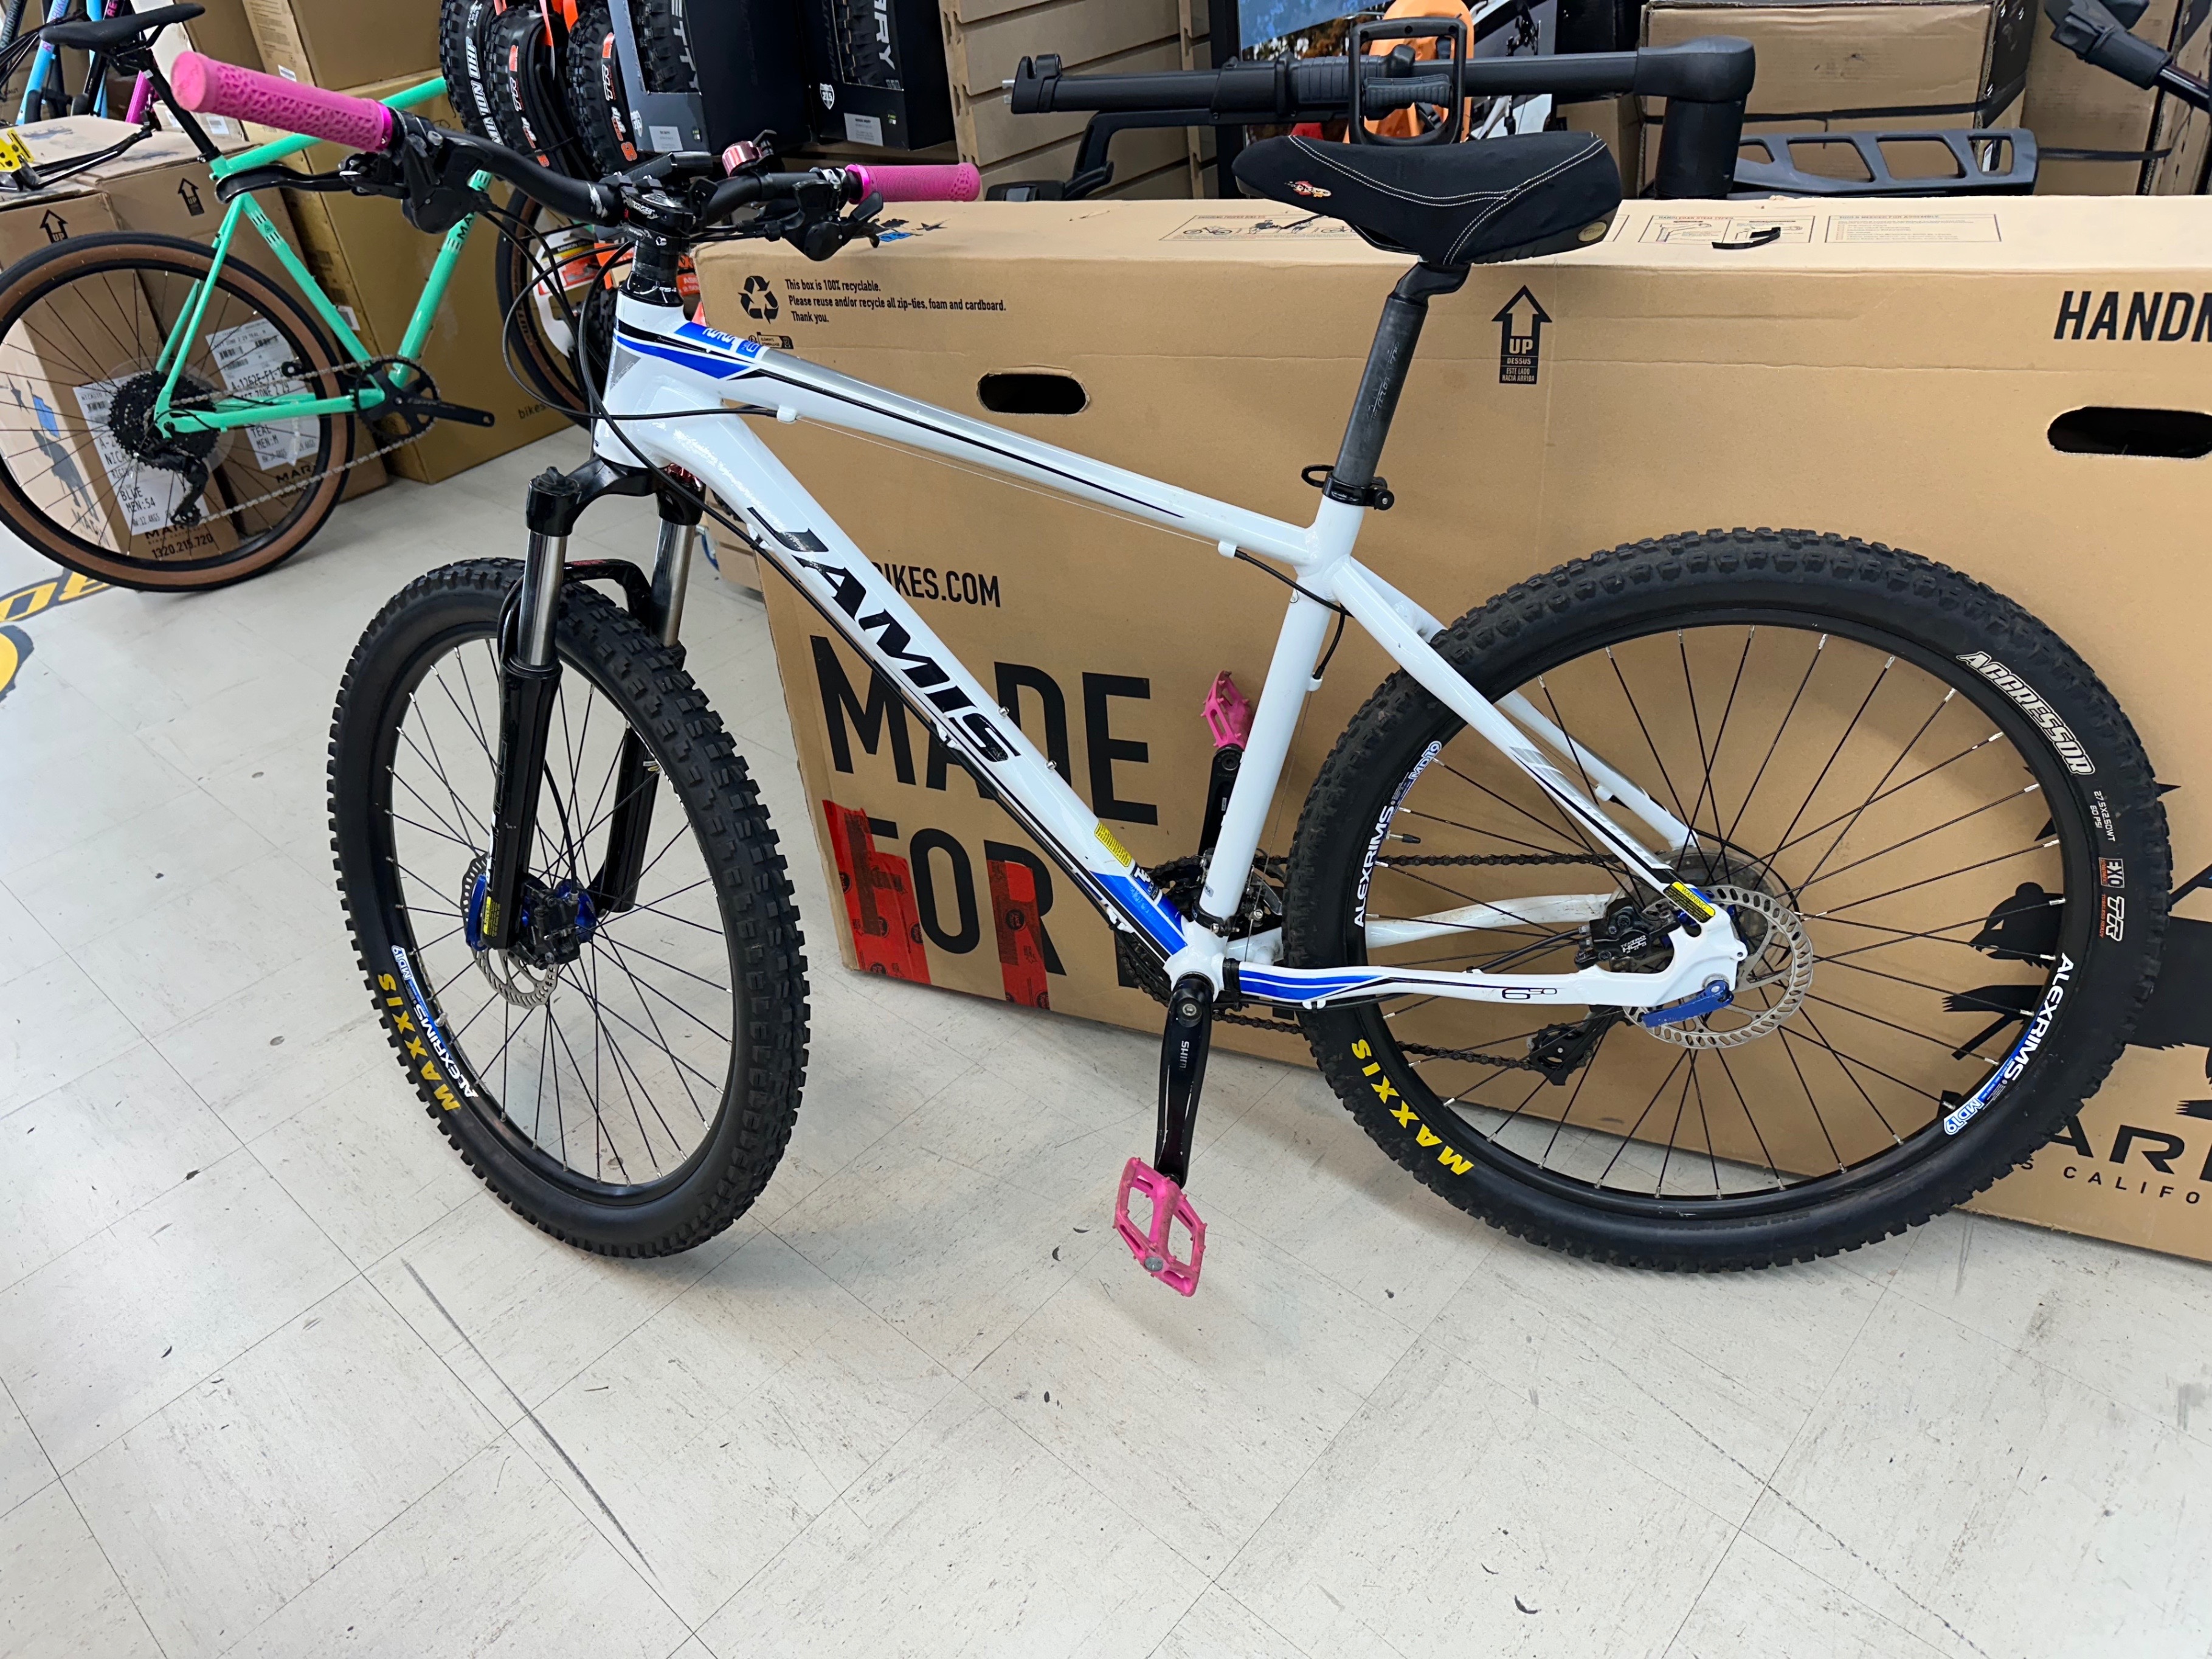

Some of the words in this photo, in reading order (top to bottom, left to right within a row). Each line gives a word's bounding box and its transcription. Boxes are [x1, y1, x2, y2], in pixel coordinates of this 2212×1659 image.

[785, 279, 800, 290] This
[801, 279, 814, 290] box
[816, 280, 822, 290] is
[823, 280, 840, 291] 100%
[842, 280, 881, 293] recyclable.
[789, 295, 812, 306] Please
[814, 297, 833, 307] reuse
[835, 296, 857, 308] and/or
[859, 297, 885, 310] recycle
[887, 297, 896, 308] all
[897, 297, 928, 311] zip-ties,
[928, 298, 947, 309] foam
[949, 299, 963, 310] and
[965, 299, 1006, 311] cardboard.
[791, 311, 812, 322] Thank
[814, 313, 829, 324] you.
[1509, 338, 1533, 354] UP
[120, 487, 143, 501] BLUE
[275, 465, 316, 483] MAR
[747, 507, 1021, 763] JAMIS
[1956, 651, 2095, 775] AGGRESSOR
[1408, 740, 1442, 781] MD19
[1354, 805, 1395, 928] ALEXRIMS
[2107, 861, 2123, 888] EXO
[844, 812, 1067, 976] FOR
[1682, 887, 1707, 910] WARNING
[2106, 896, 2124, 941] TR
[391, 945, 412, 980] MD19
[2012, 952, 2074, 1081] ALEXRIMS
[378, 973, 461, 1111] MAXXIS
[413, 1003, 479, 1098] ALEXRIMS
[1351, 1037, 1474, 1176] MAXXIS
[1944, 1097, 1984, 1137] MD19
